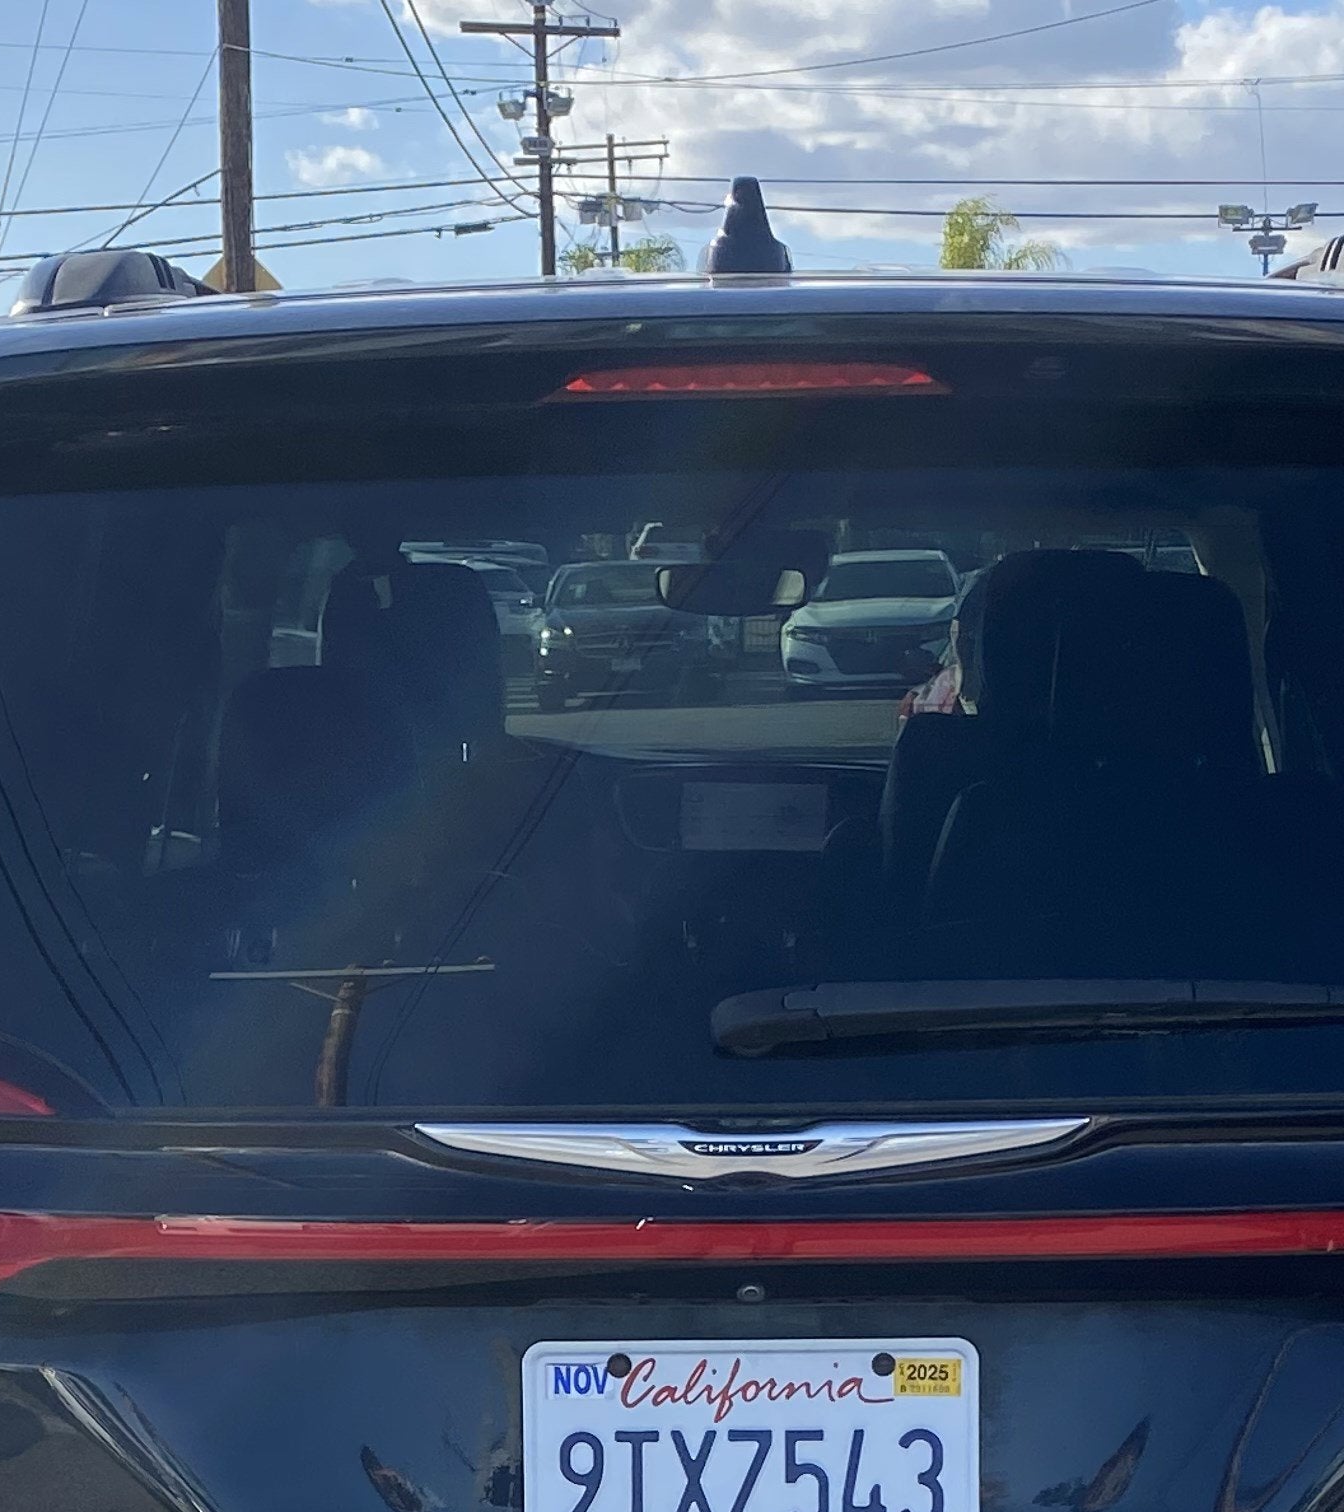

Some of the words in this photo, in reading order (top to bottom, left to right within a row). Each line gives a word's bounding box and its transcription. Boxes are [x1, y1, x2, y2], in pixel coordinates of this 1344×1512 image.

[693, 1142, 806, 1154] CHRYSLER
[554, 1366, 609, 1395] NOV
[906, 1363, 949, 1381] 2025
[620, 1357, 895, 1423] California
